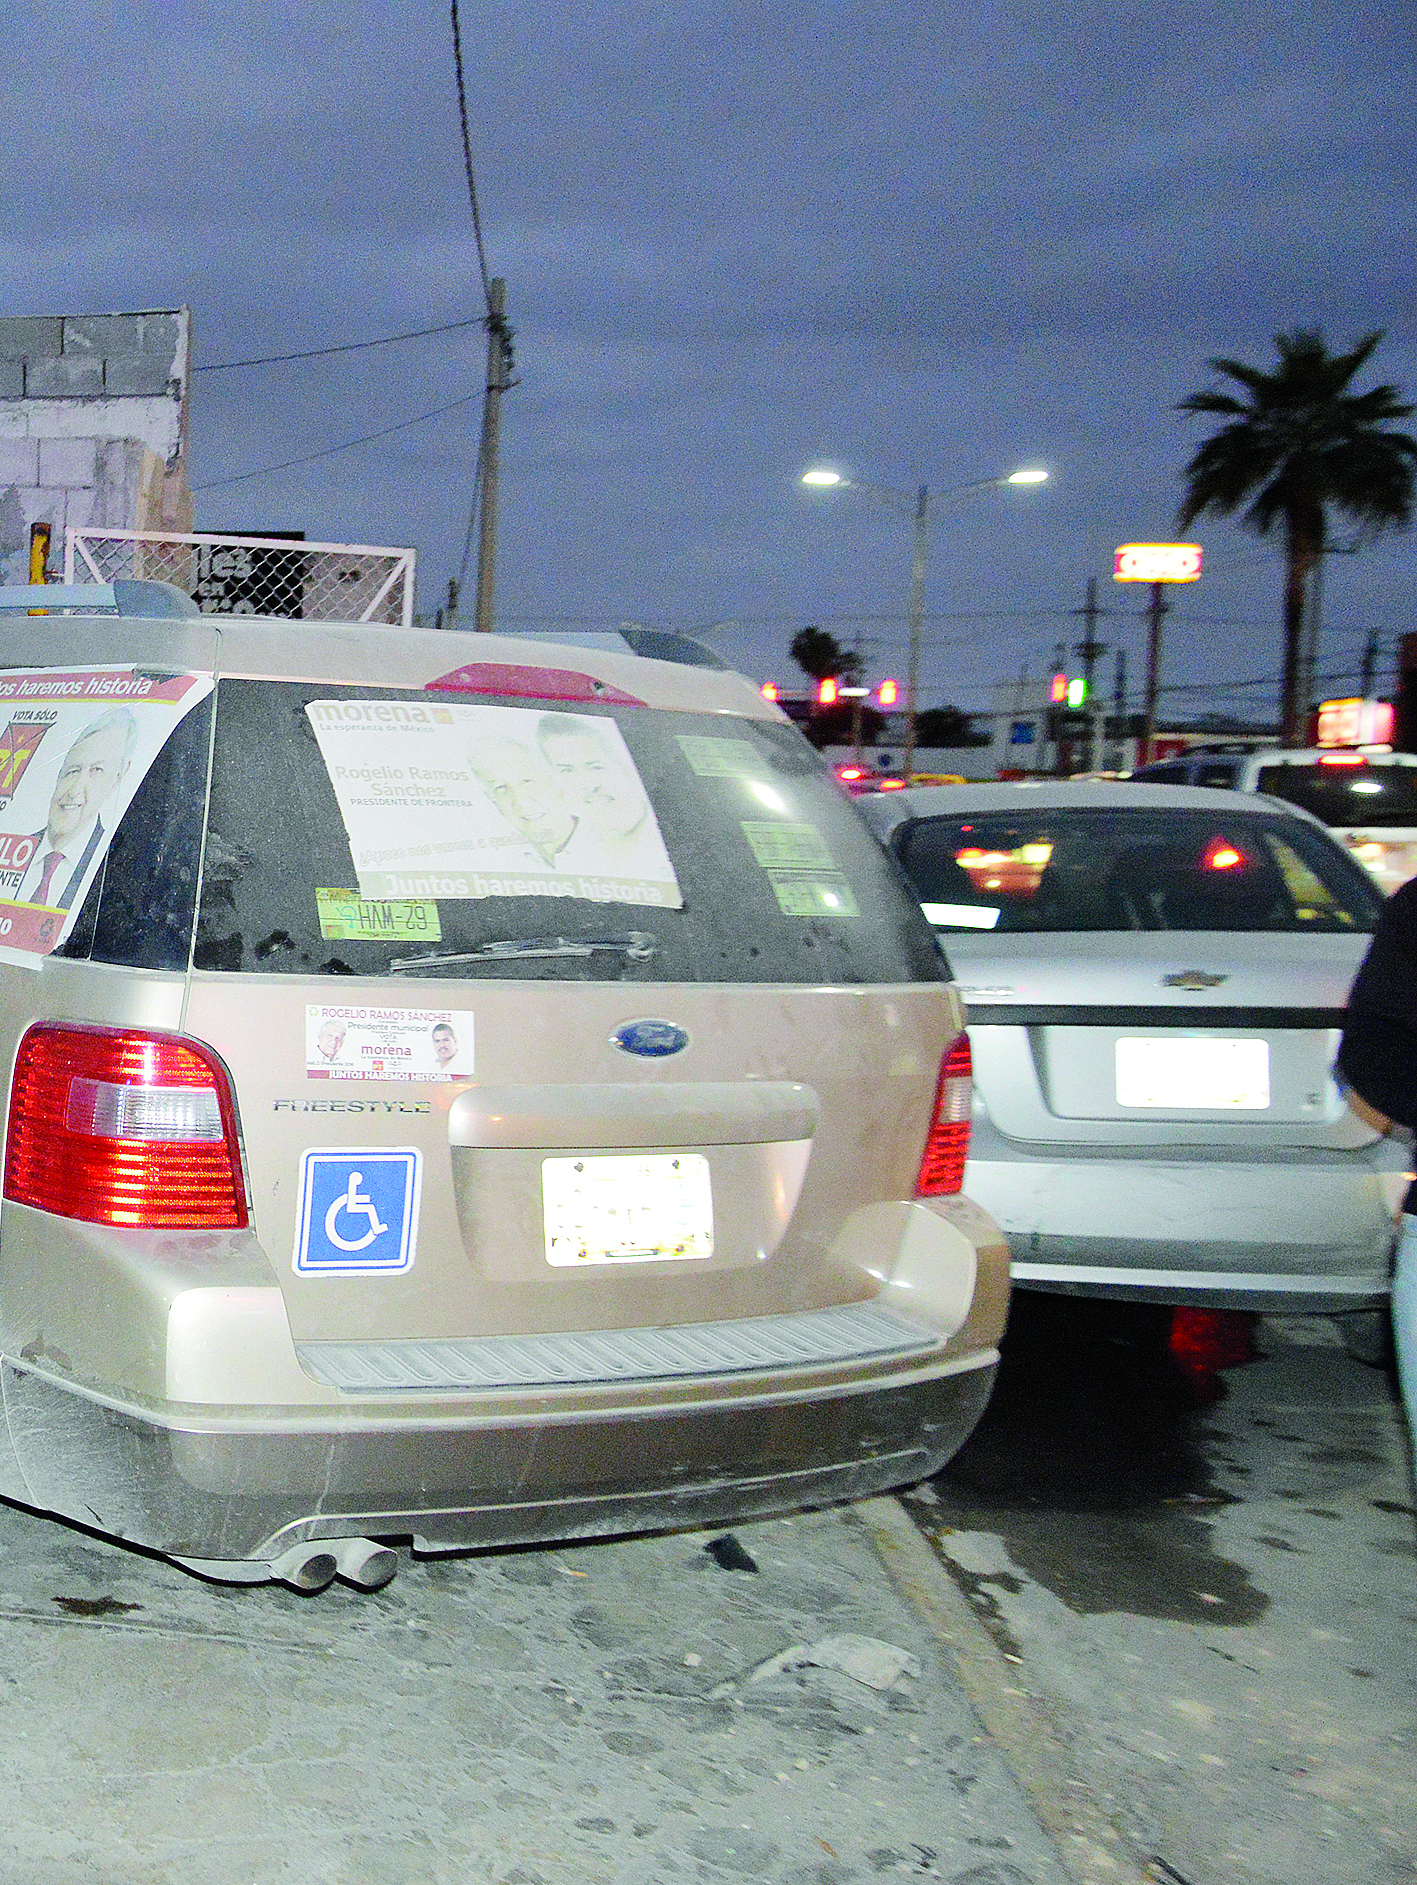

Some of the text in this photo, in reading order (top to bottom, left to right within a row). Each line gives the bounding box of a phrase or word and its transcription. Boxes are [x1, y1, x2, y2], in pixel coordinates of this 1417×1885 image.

[15, 679, 84, 696] haremos
[84, 677, 153, 695] historia
[12, 708, 58, 720] VOTA SÓLO
[312, 704, 431, 724] morena
[319, 723, 332, 731] La
[334, 724, 384, 736] esperanza
[385, 724, 398, 732] de
[334, 765, 470, 782] Rogelio Ramos
[371, 782, 447, 797] Sánchez
[350, 798, 473, 807] PRESIDENTE DE FRONTERA
[384, 874, 470, 896] Juntos
[473, 873, 573, 896] haremos
[578, 877, 663, 903] historia
[322, 1008, 452, 1022] ROGELIO RAMOS SÁNCHEZ
[347, 1021, 429, 1033] Presidente municipal
[361, 1045, 412, 1056] morena
[329, 1070, 453, 1082] JUNTOS HAREMOS HISTORIA
[272, 1099, 431, 1113] FREESTYLE
